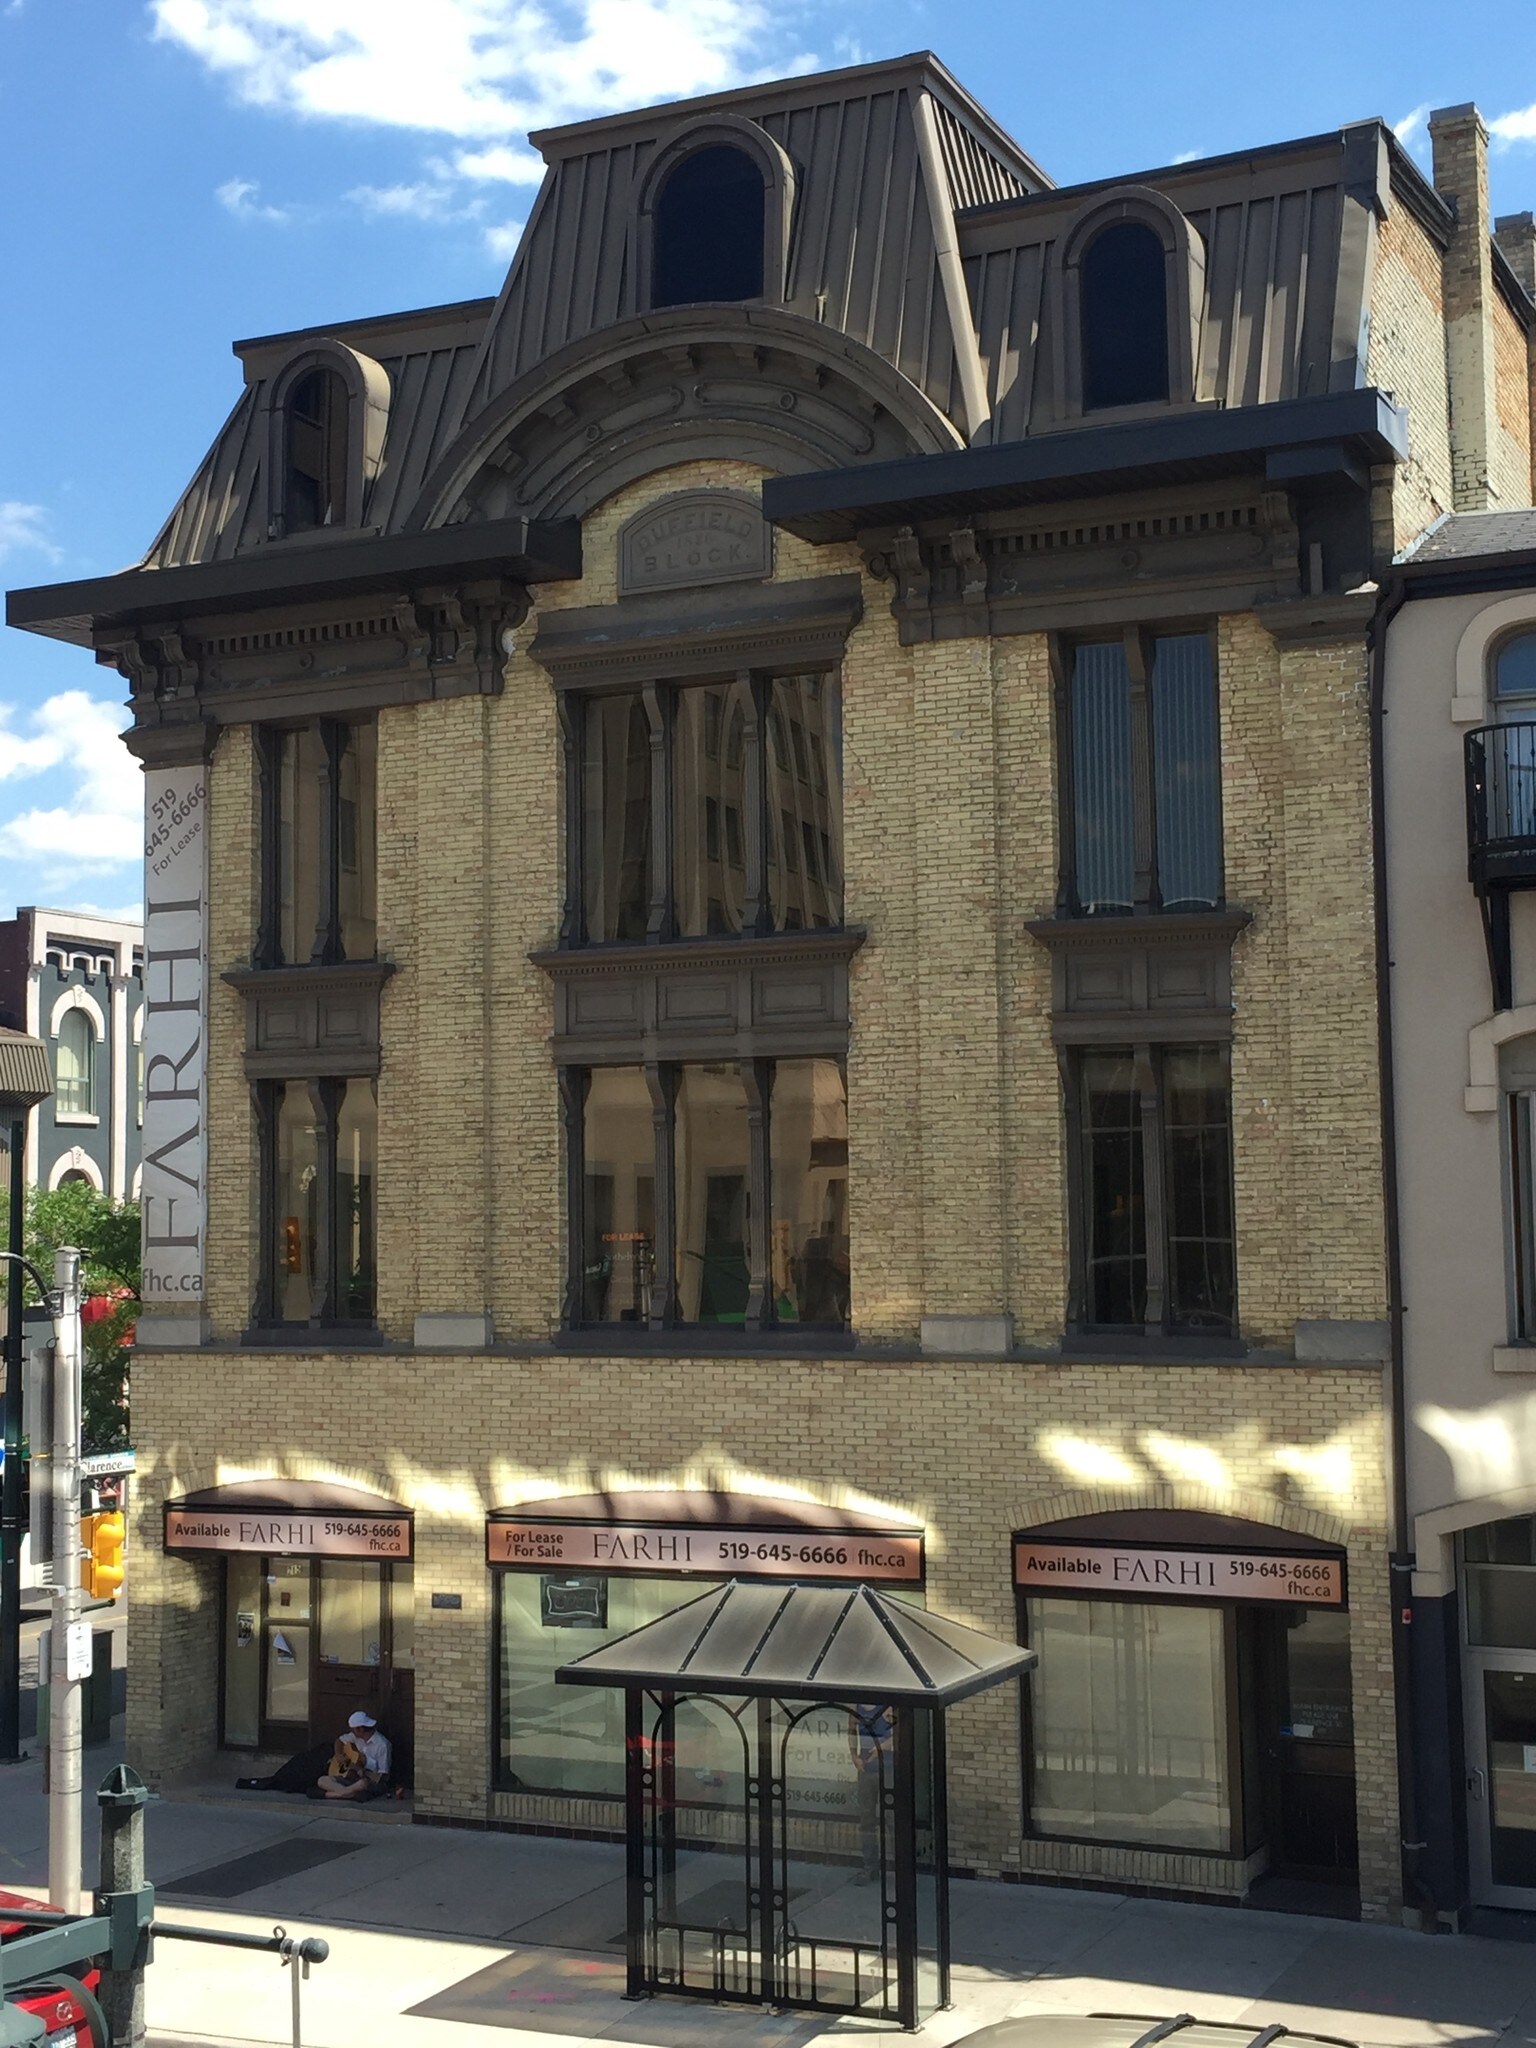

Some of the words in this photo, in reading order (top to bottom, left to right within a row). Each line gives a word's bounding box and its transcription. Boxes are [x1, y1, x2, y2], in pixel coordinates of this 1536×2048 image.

[151, 788, 177, 820] 519
[144, 783, 207, 857] 645-6666
[152, 853, 172, 876] For
[170, 822, 202, 857] Lease
[144, 889, 201, 1257] FARHI
[142, 1268, 203, 1293] fhc.ca
[174, 1522, 231, 1537] Available
[239, 1521, 315, 1545] FARHI
[325, 1522, 401, 1538] 519-645-6666
[369, 1539, 401, 1551] fhc.ca
[505, 1530, 526, 1543] For
[528, 1531, 564, 1545] Lease
[514, 1543, 532, 1557] For
[534, 1544, 563, 1559] Sale
[593, 1533, 692, 1562] FARHI
[719, 1541, 848, 1565] 519-645-6666
[857, 1548, 906, 1568] fhc.ca
[1027, 1556, 1102, 1575] Available
[1112, 1557, 1217, 1586] FARHI
[1230, 1561, 1330, 1581] 519-645-6666
[1287, 1581, 1331, 1598] fhc.ca
[786, 1746, 812, 1761] For
[817, 1747, 854, 1764] Leas
